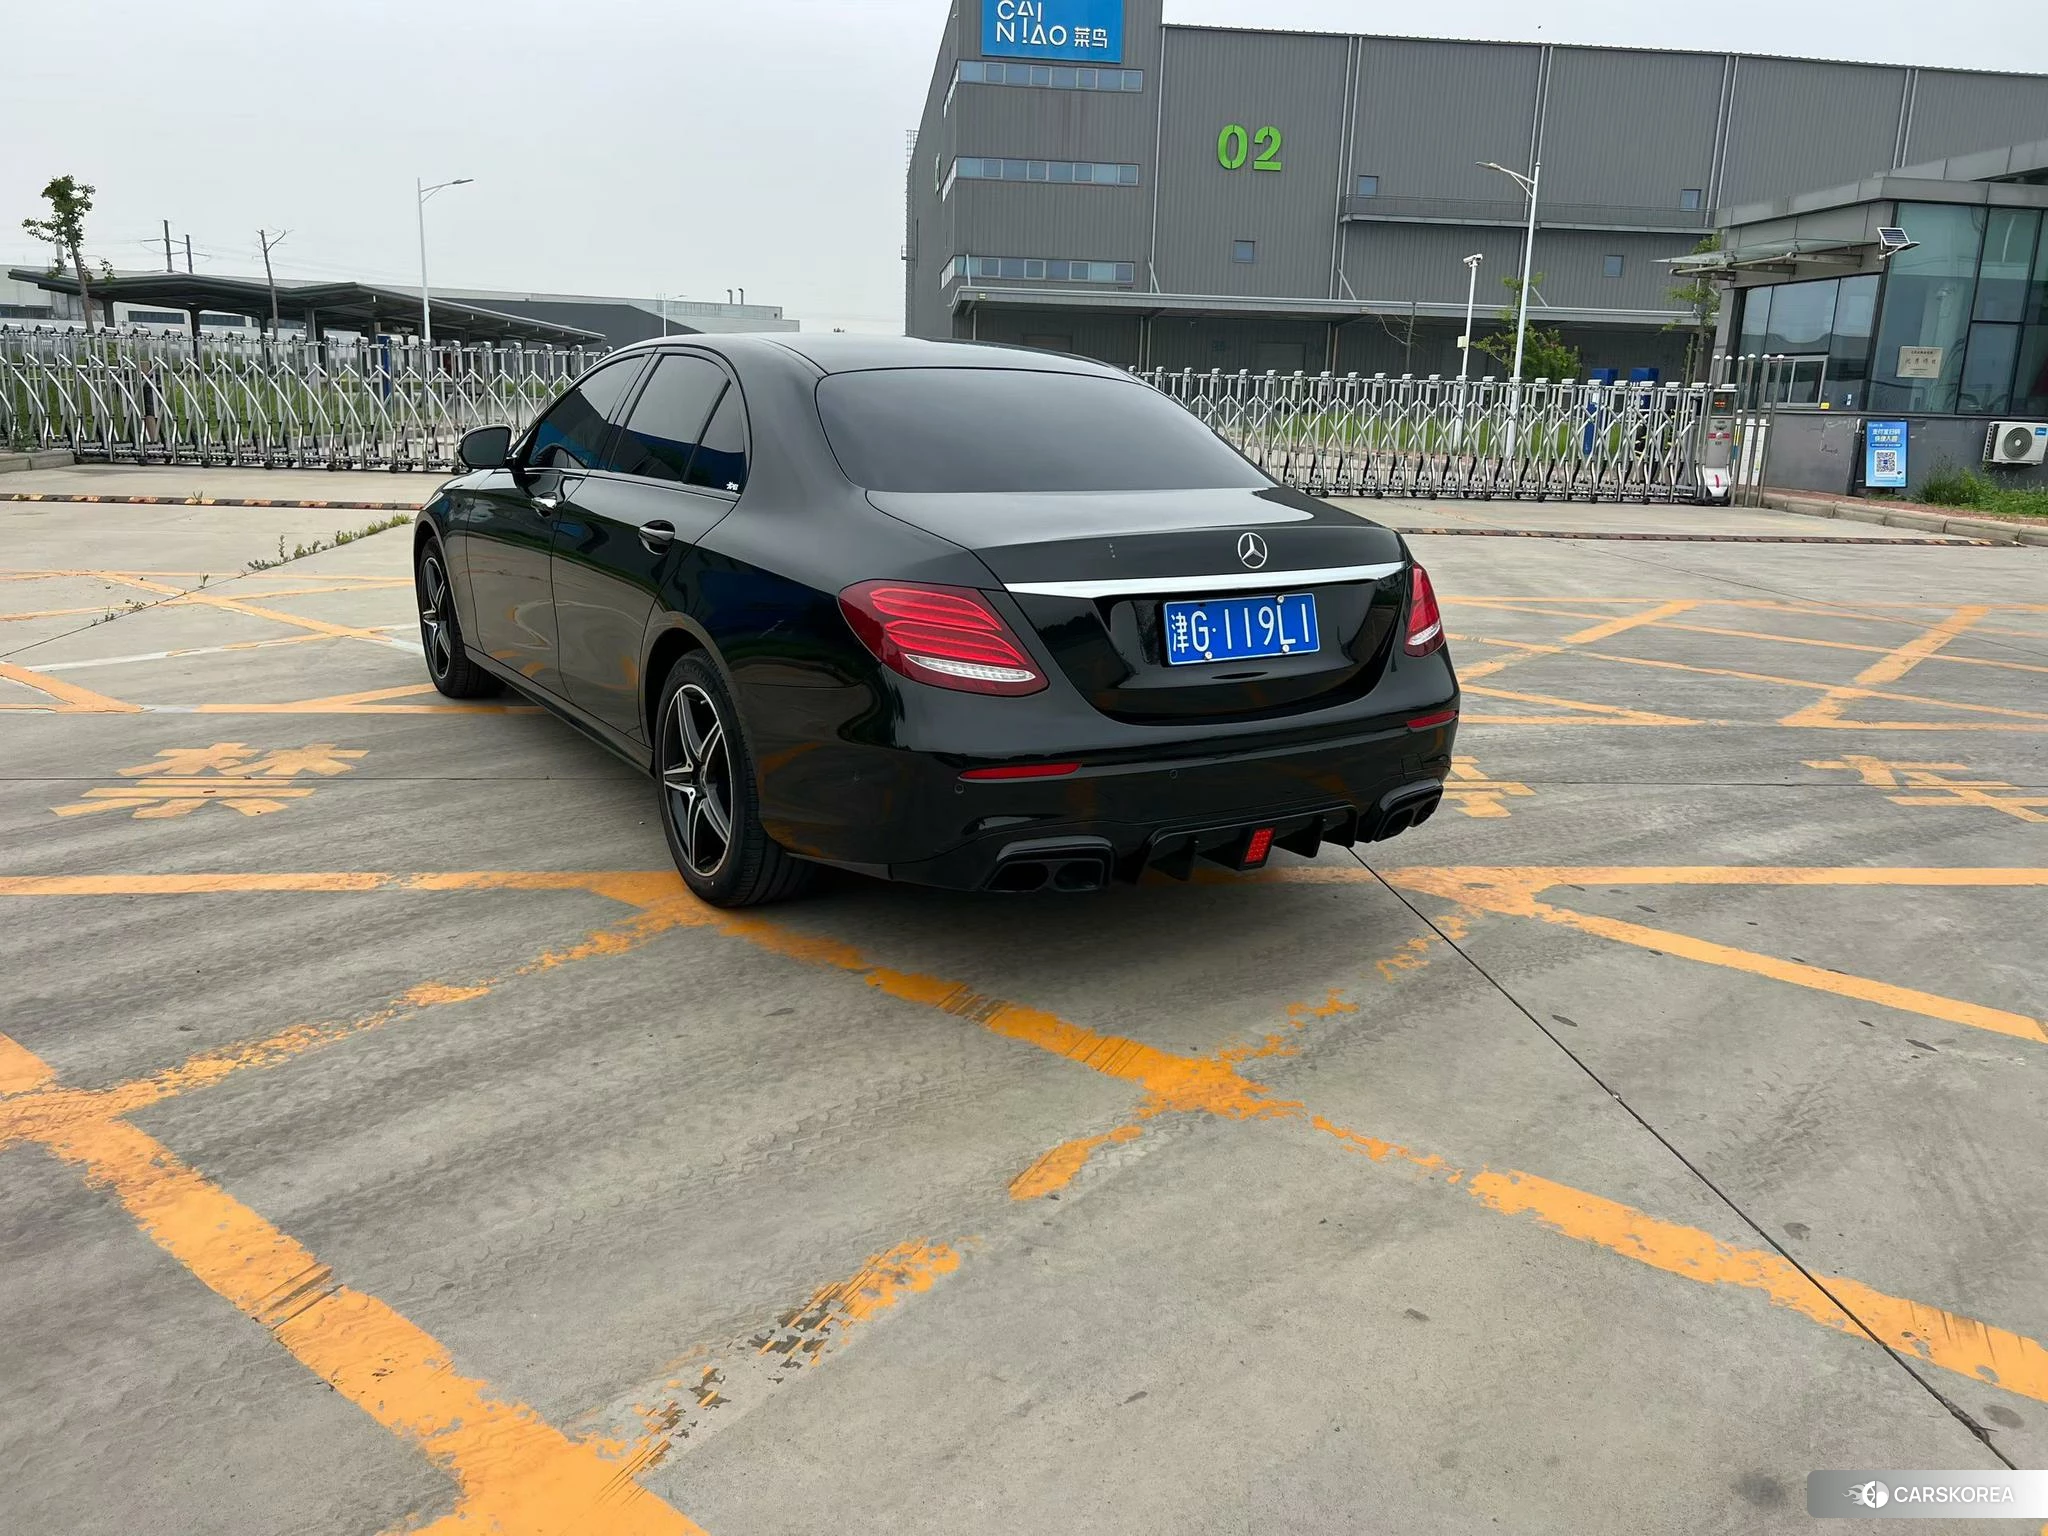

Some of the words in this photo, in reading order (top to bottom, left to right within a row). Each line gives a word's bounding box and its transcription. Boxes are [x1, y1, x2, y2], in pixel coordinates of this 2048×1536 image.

[997, 0, 1042, 22] CAI
[1074, 26, 1108, 49] 菜鸟
[1217, 124, 1282, 172] 02
